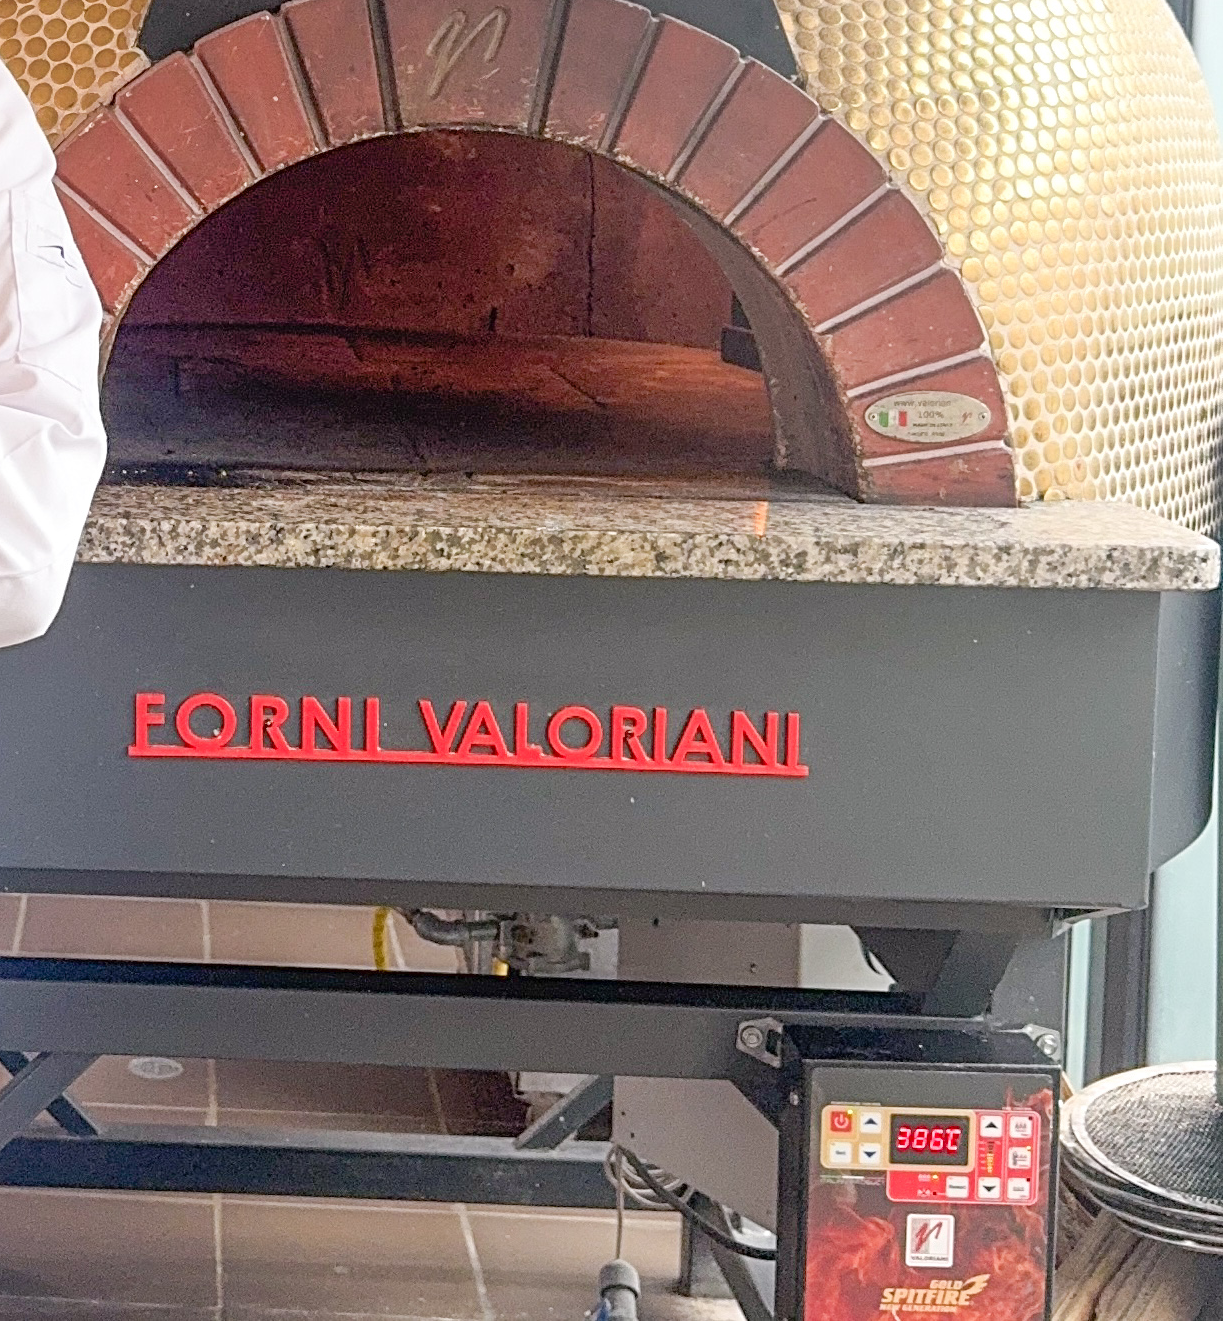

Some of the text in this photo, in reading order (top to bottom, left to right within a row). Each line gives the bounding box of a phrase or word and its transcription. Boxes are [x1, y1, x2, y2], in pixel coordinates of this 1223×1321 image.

[917, 410, 944, 419] 100%
[130, 692, 803, 771] FORNI VALORIANI
[929, 1279, 963, 1289] GOLD
[880, 1287, 970, 1306] SPITFIRE
